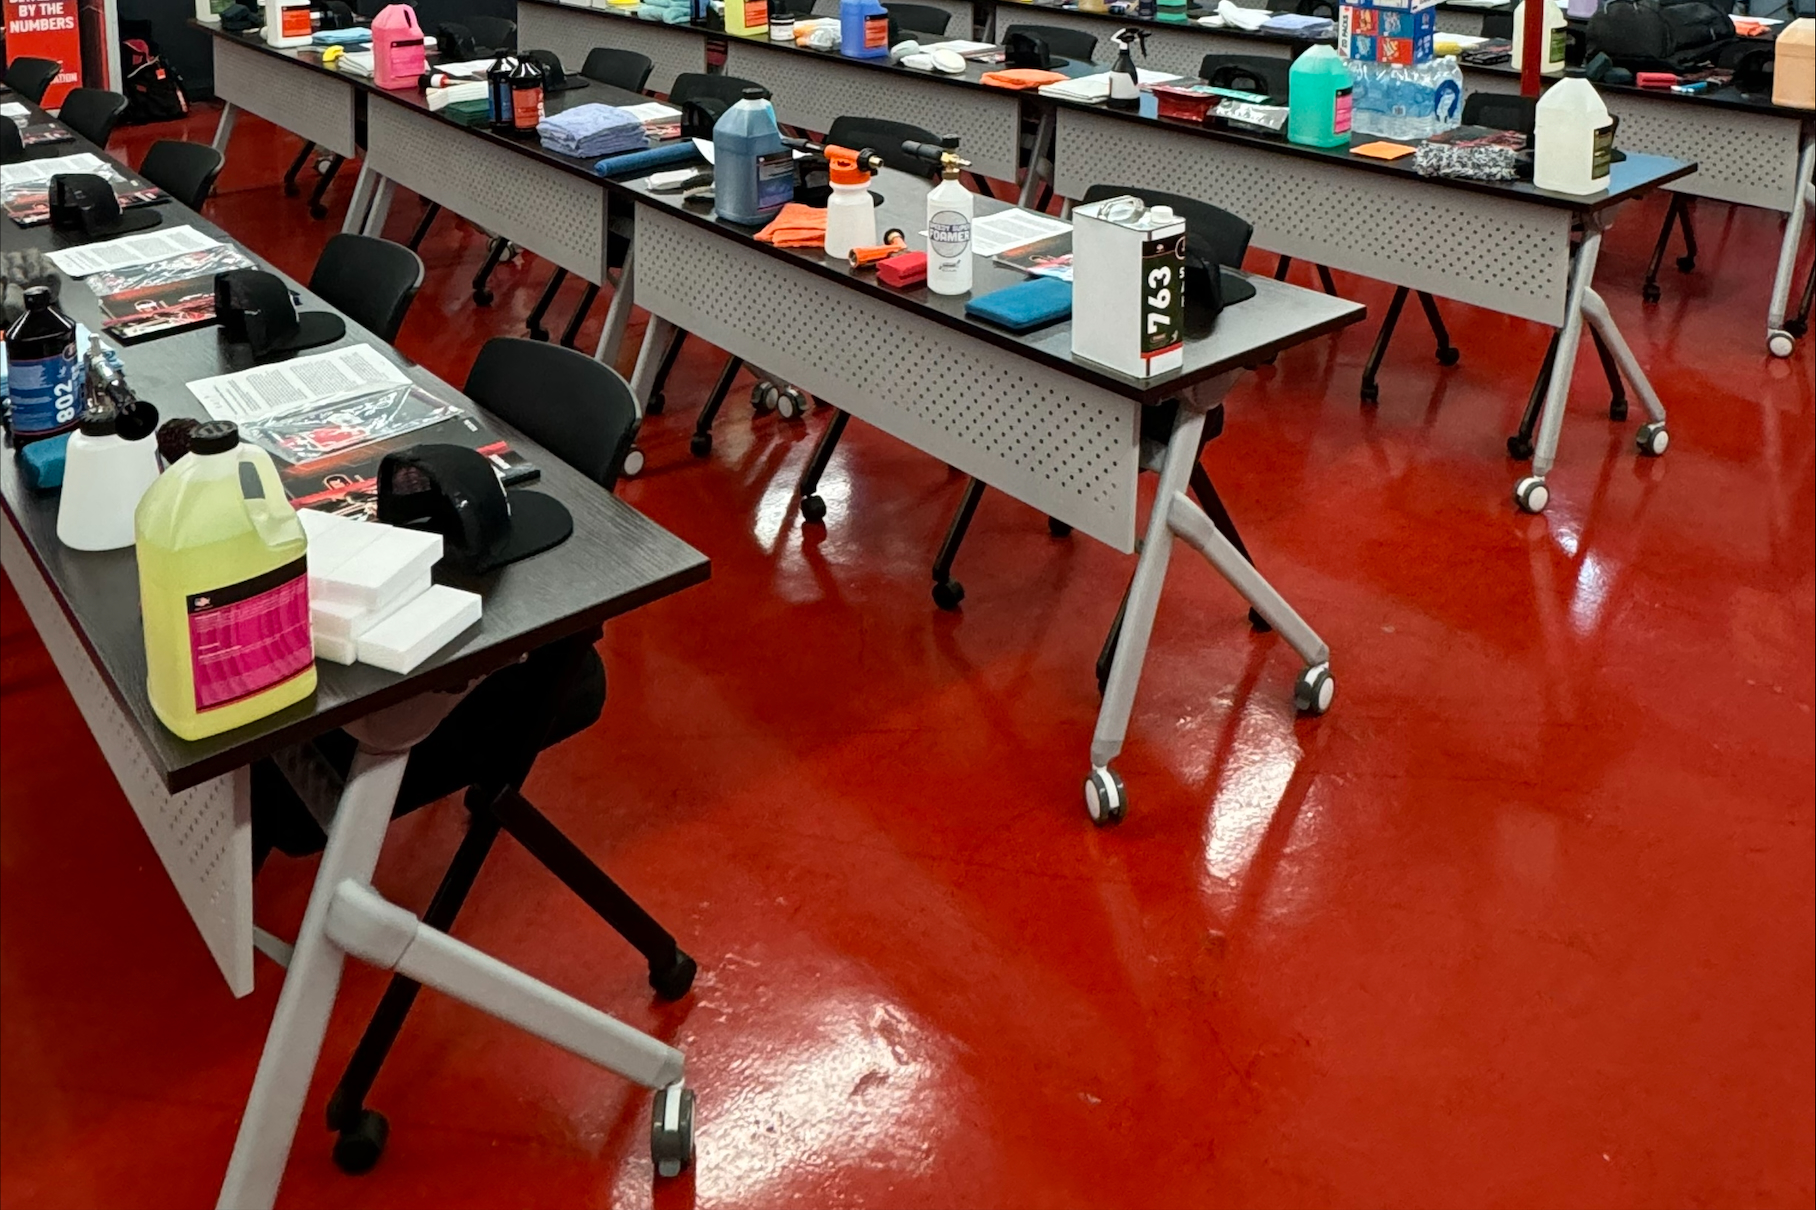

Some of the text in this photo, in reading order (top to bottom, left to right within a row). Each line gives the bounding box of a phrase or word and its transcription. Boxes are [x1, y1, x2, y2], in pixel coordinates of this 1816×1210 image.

[9, 16, 75, 34] NUMBERS
[18, 2, 65, 18] BY THE
[1147, 265, 1172, 334] 763
[53, 379, 75, 424] 802
